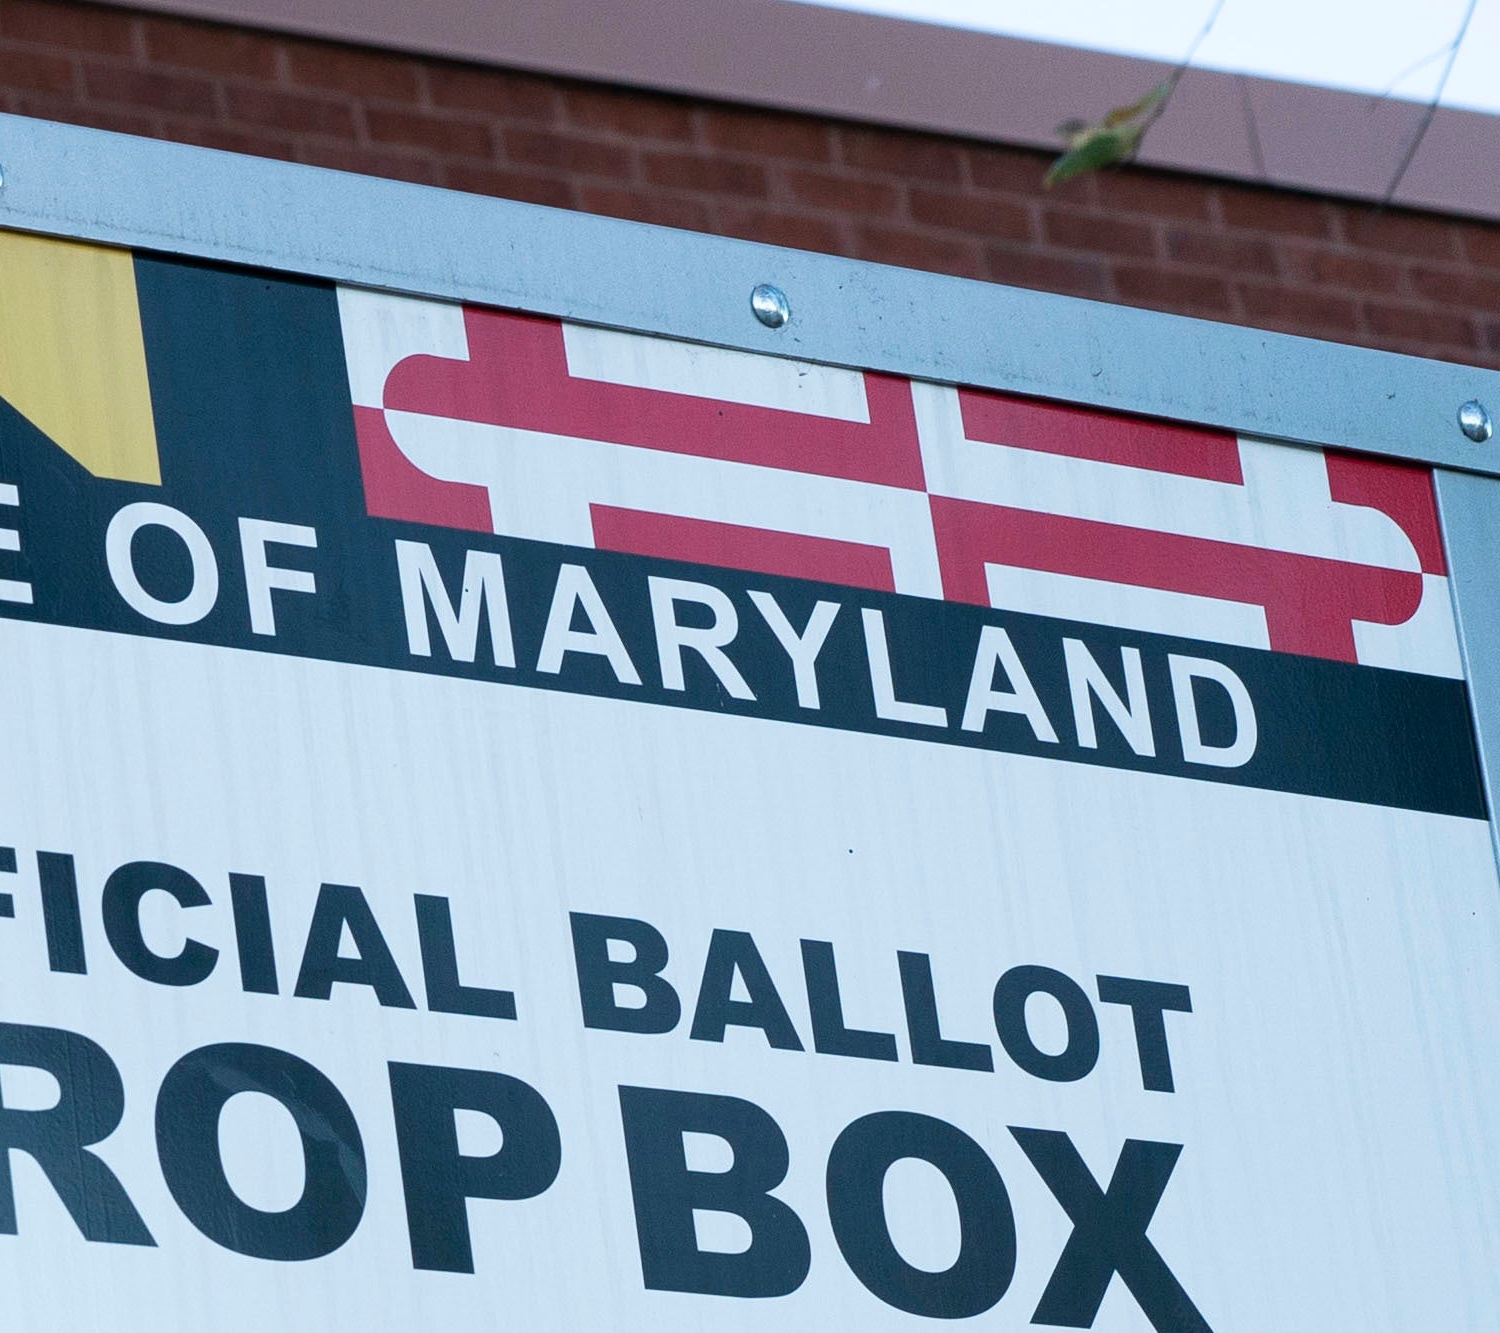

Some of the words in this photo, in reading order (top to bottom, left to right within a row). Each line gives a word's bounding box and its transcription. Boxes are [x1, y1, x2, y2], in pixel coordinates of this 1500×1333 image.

[105, 502, 318, 636] OF
[400, 541, 1258, 771] MARYLAND
[569, 912, 1193, 1093] BALLOT
